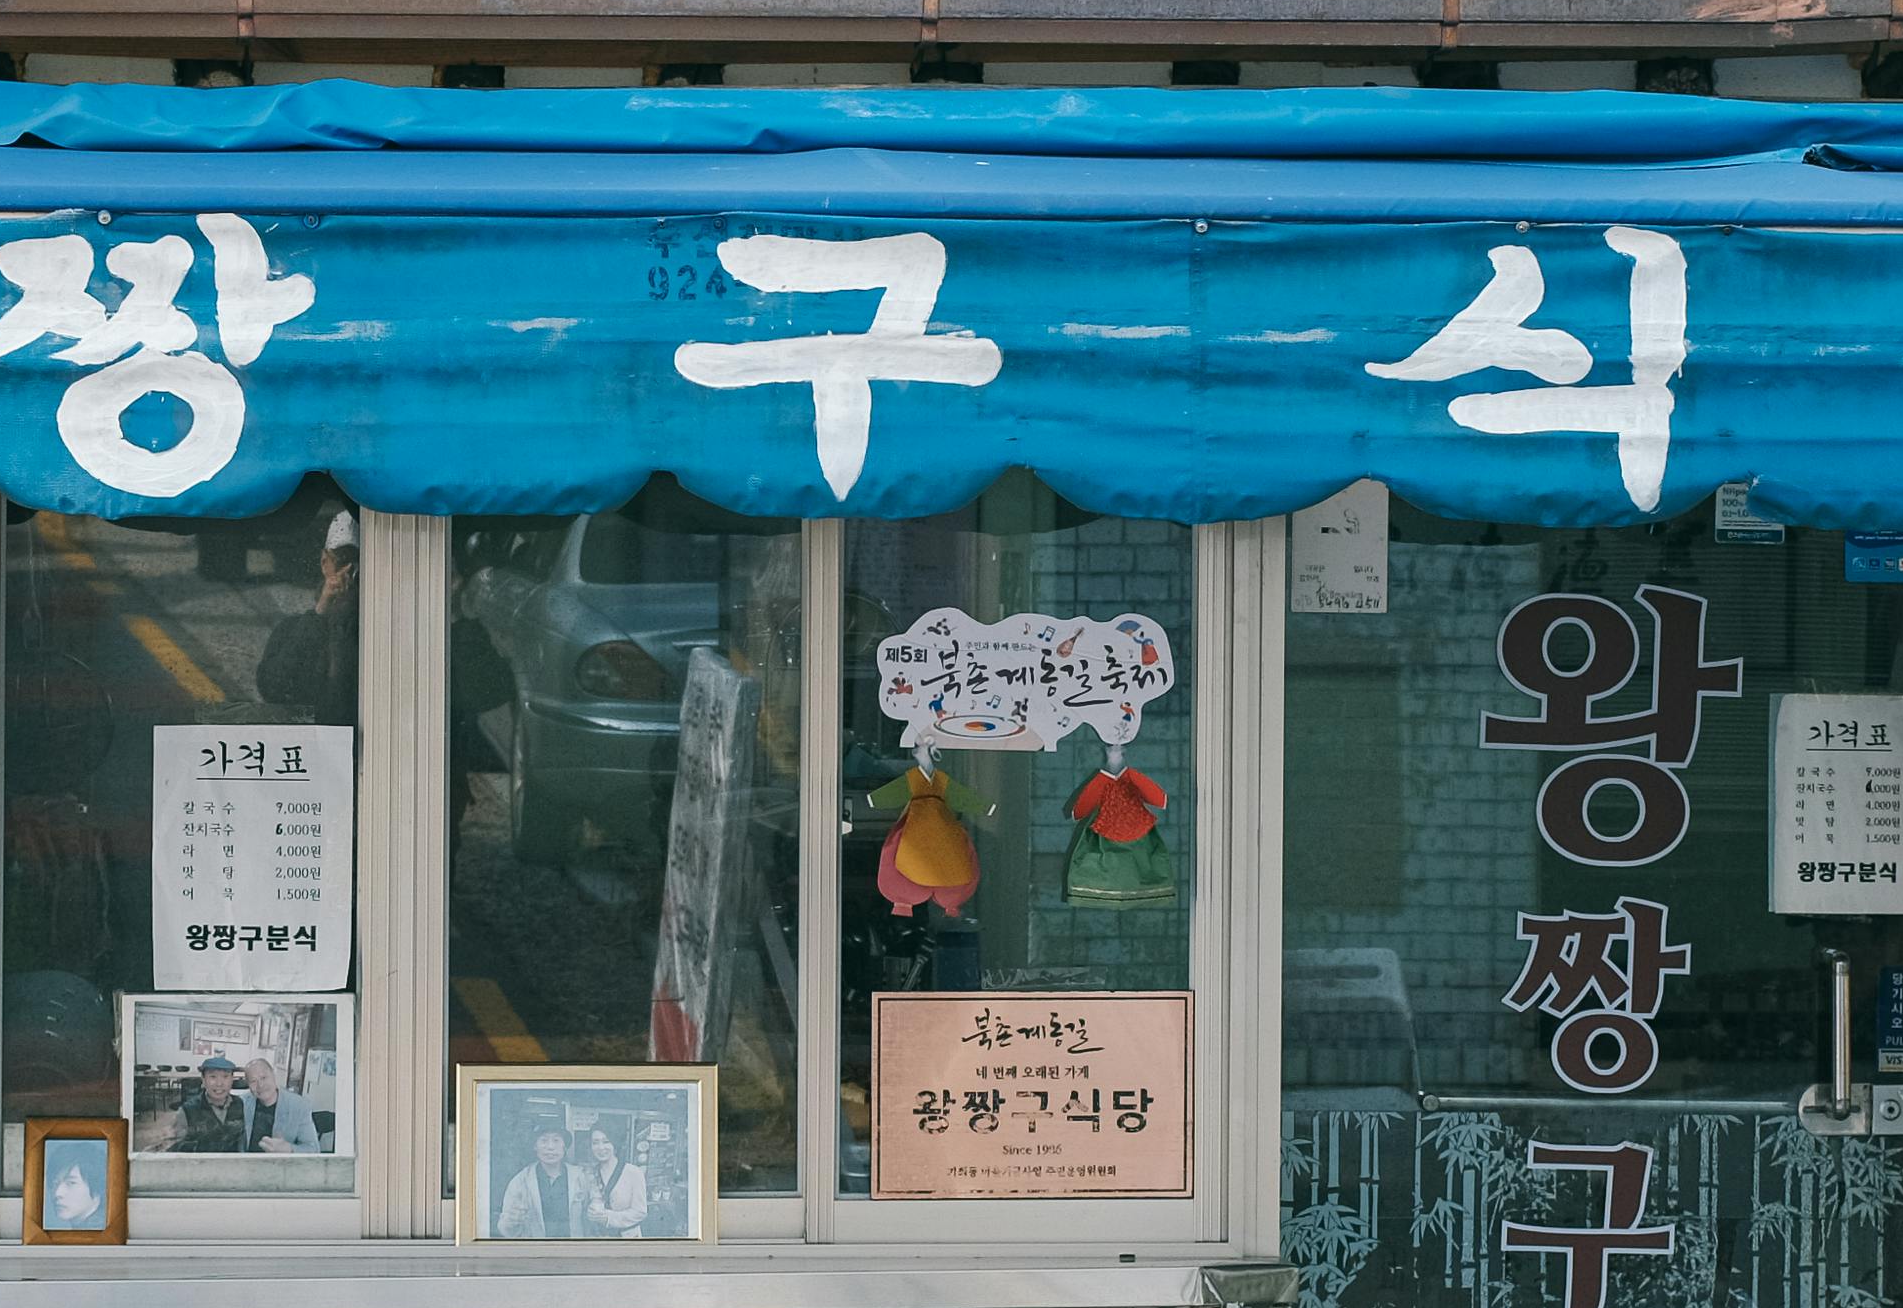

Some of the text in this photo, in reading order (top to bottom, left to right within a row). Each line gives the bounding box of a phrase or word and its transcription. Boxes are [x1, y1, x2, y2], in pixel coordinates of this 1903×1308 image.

[275, 845, 323, 859] 4,000원
[275, 867, 323, 881] 2,000원
[1797, 862, 1897, 883] 왕짱구분식
[276, 888, 322, 902] 1,500원
[185, 924, 317, 952] 왕짱구분식
[1890, 972, 1903, 1029] 당기시오
[1002, 1145, 1032, 1155] Since
